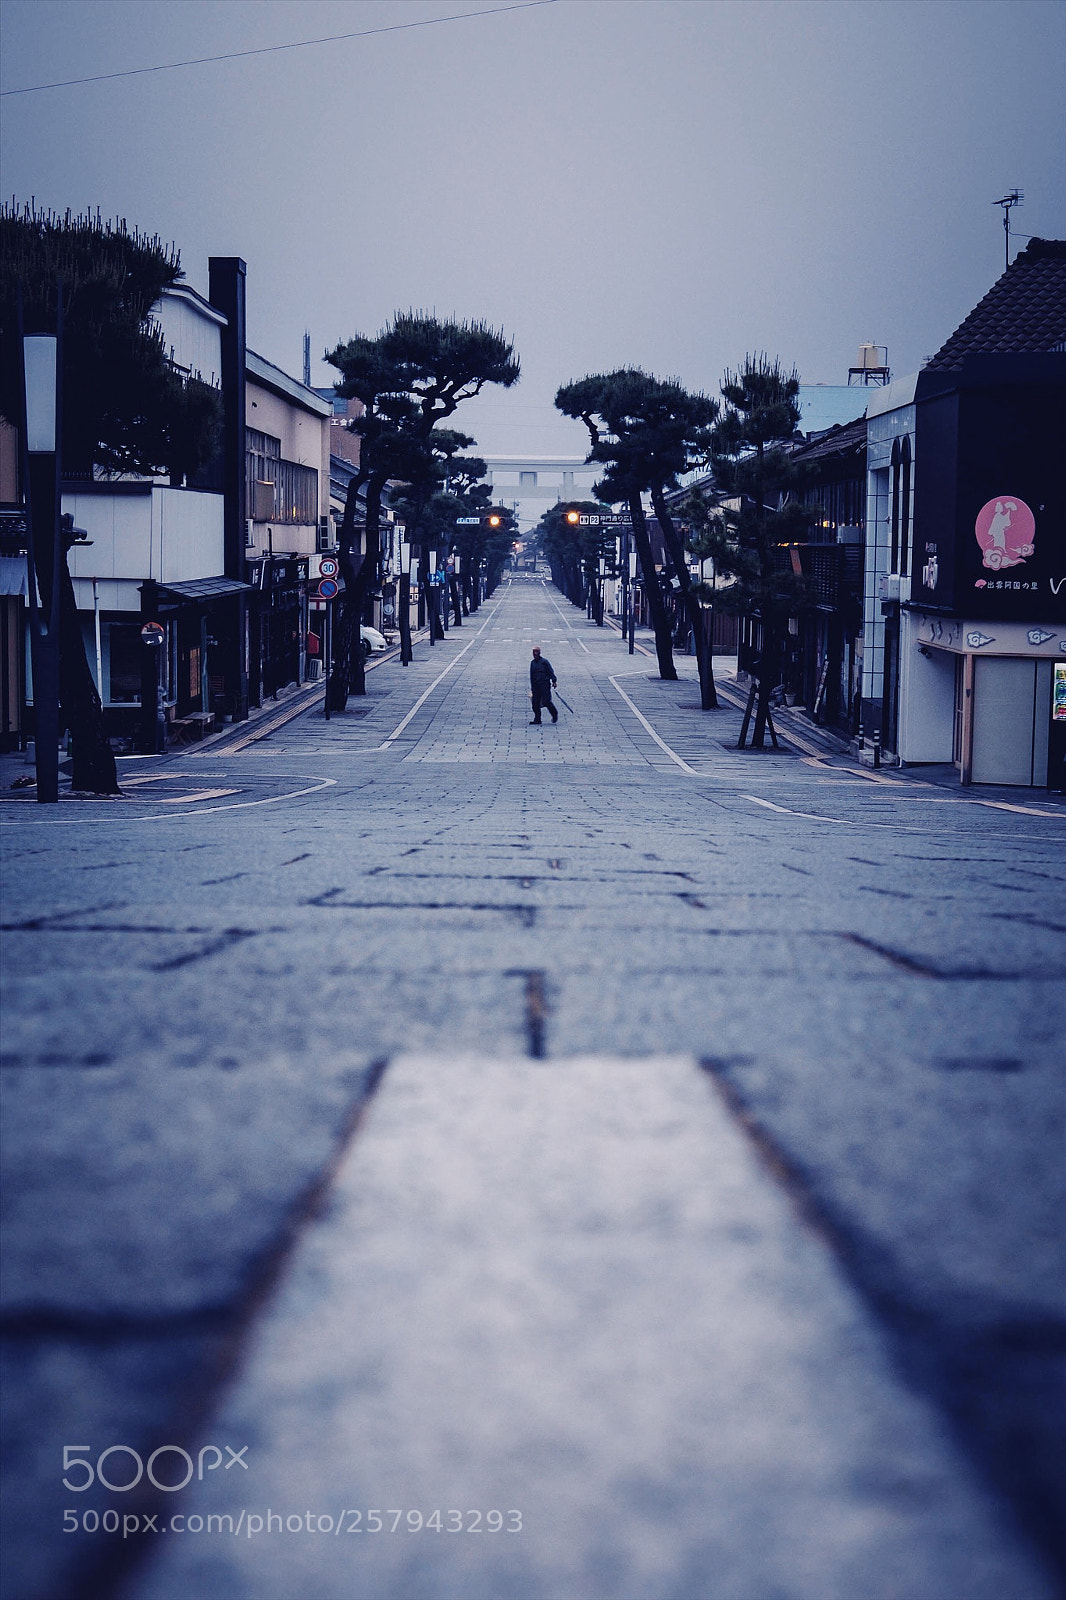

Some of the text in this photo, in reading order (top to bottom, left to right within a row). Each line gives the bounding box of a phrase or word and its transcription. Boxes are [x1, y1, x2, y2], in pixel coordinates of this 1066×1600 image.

[323, 564, 334, 572] 30
[987, 580, 1039, 590] 出雲阿国の里
